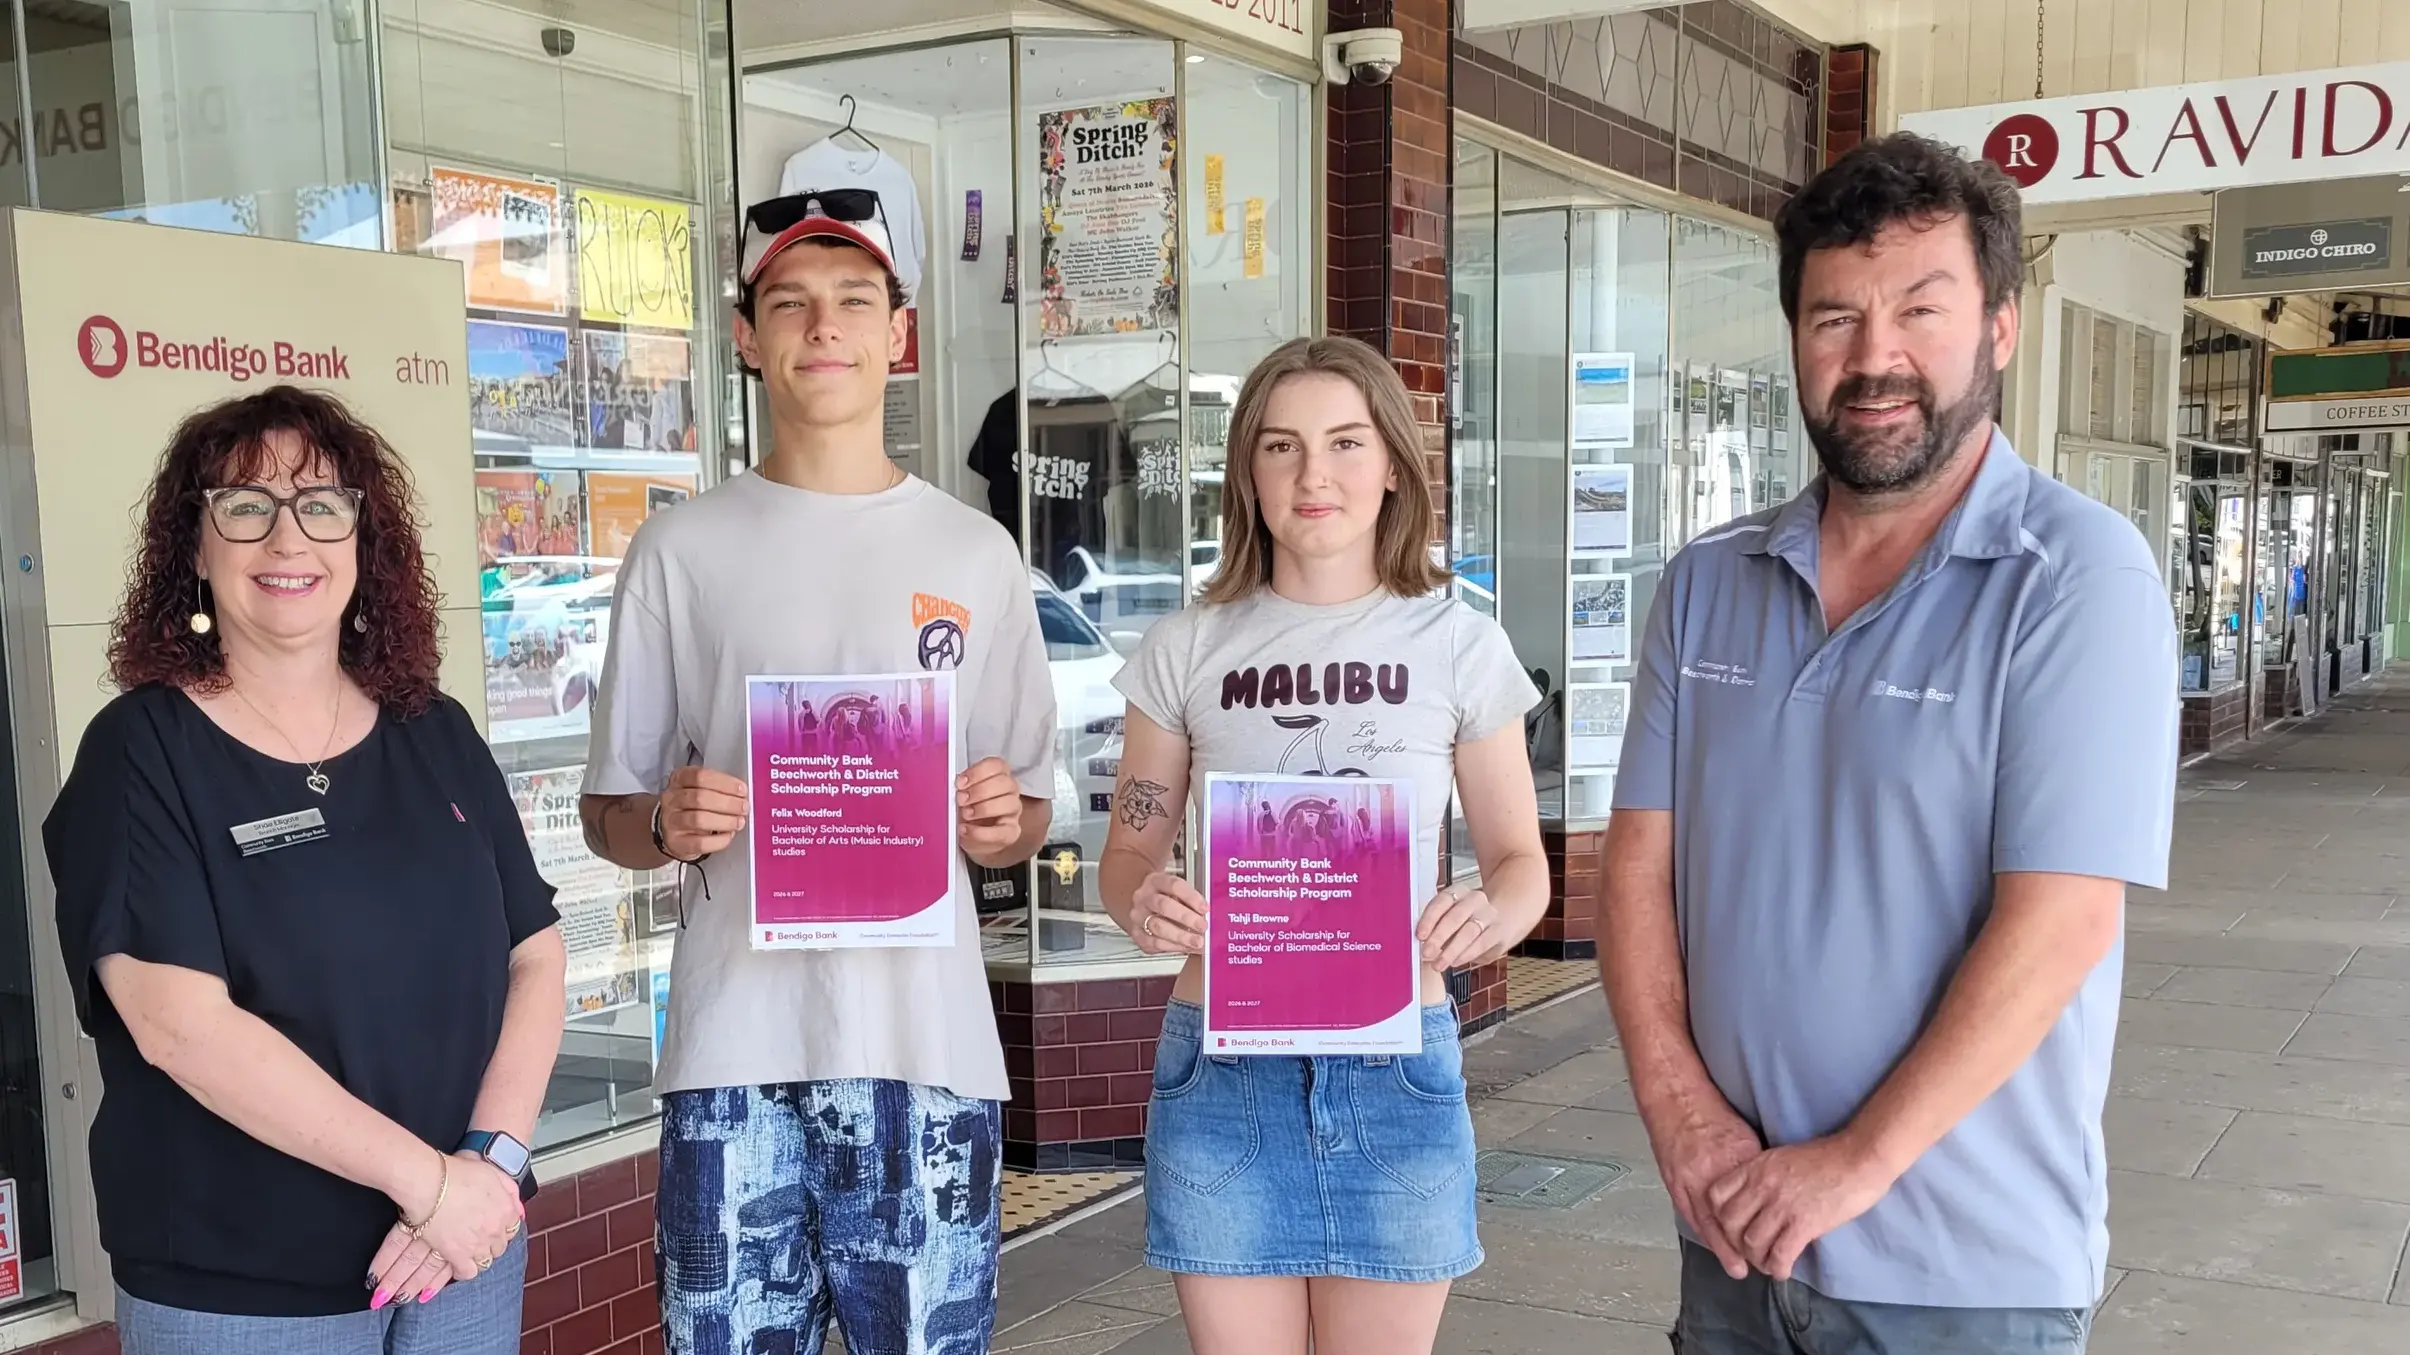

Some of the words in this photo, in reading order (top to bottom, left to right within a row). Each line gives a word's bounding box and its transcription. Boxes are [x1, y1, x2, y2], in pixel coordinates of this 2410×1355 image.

[1073, 121, 1148, 145] Spring
[1077, 141, 1144, 164] Ditch!
[1071, 188, 1085, 197] Sat
[1088, 185, 1103, 195] 7th
[1105, 183, 1131, 193] March
[2255, 247, 2318, 263] INDIGO
[2321, 243, 2376, 257] CHIRO
[137, 331, 266, 381] Bendigo
[274, 341, 350, 380] Bank
[396, 351, 449, 385] atm
[2326, 405, 2388, 420] COFFEE
[1144, 453, 1180, 470] Spri
[1220, 661, 1410, 710] MALIBU
[506, 688, 527, 702] good
[529, 686, 553, 698] things
[1352, 721, 1378, 738] Los
[1347, 739, 1407, 761] Angeles
[770, 755, 839, 767] Community
[842, 755, 873, 765] Bank
[770, 769, 841, 780] Beechworth
[844, 770, 853, 780] &
[856, 769, 899, 780] District
[771, 783, 839, 796] Scholarship
[842, 784, 893, 796] Program
[771, 808, 792, 818] Felix
[796, 808, 842, 818] Woodford
[772, 824, 817, 836] University
[820, 824, 875, 836] Scholarship
[877, 824, 890, 834] for
[772, 836, 814, 845] Bachelor
[816, 836, 826, 845] of
[828, 836, 849, 845] Arts
[851, 836, 881, 846] (Music
[883, 836, 924, 847] Industry)
[568, 854, 590, 862] March
[772, 847, 806, 857] studies
[1228, 858, 1297, 871] Community
[1300, 858, 1331, 869] Bank
[1228, 873, 1299, 884] Beechworth
[1303, 873, 1311, 883] &
[1315, 873, 1358, 884] District
[1228, 887, 1297, 900] Scholarship
[1300, 887, 1351, 901] Program
[1228, 914, 1250, 925] Tahji
[1253, 914, 1289, 923] Browne
[778, 931, 813, 941] Bendigo
[815, 931, 838, 940] Bank
[1228, 930, 1275, 942] University
[1278, 930, 1334, 942] Scholarship
[1336, 930, 1350, 940] for
[1228, 943, 1271, 952] Bachelor
[1274, 942, 1284, 952] of
[1286, 941, 1340, 952] Biomedical
[1343, 941, 1382, 951] Science
[1228, 955, 1262, 965] studies
[1231, 1038, 1268, 1048] Bendigo
[1271, 1038, 1295, 1047] Bank
